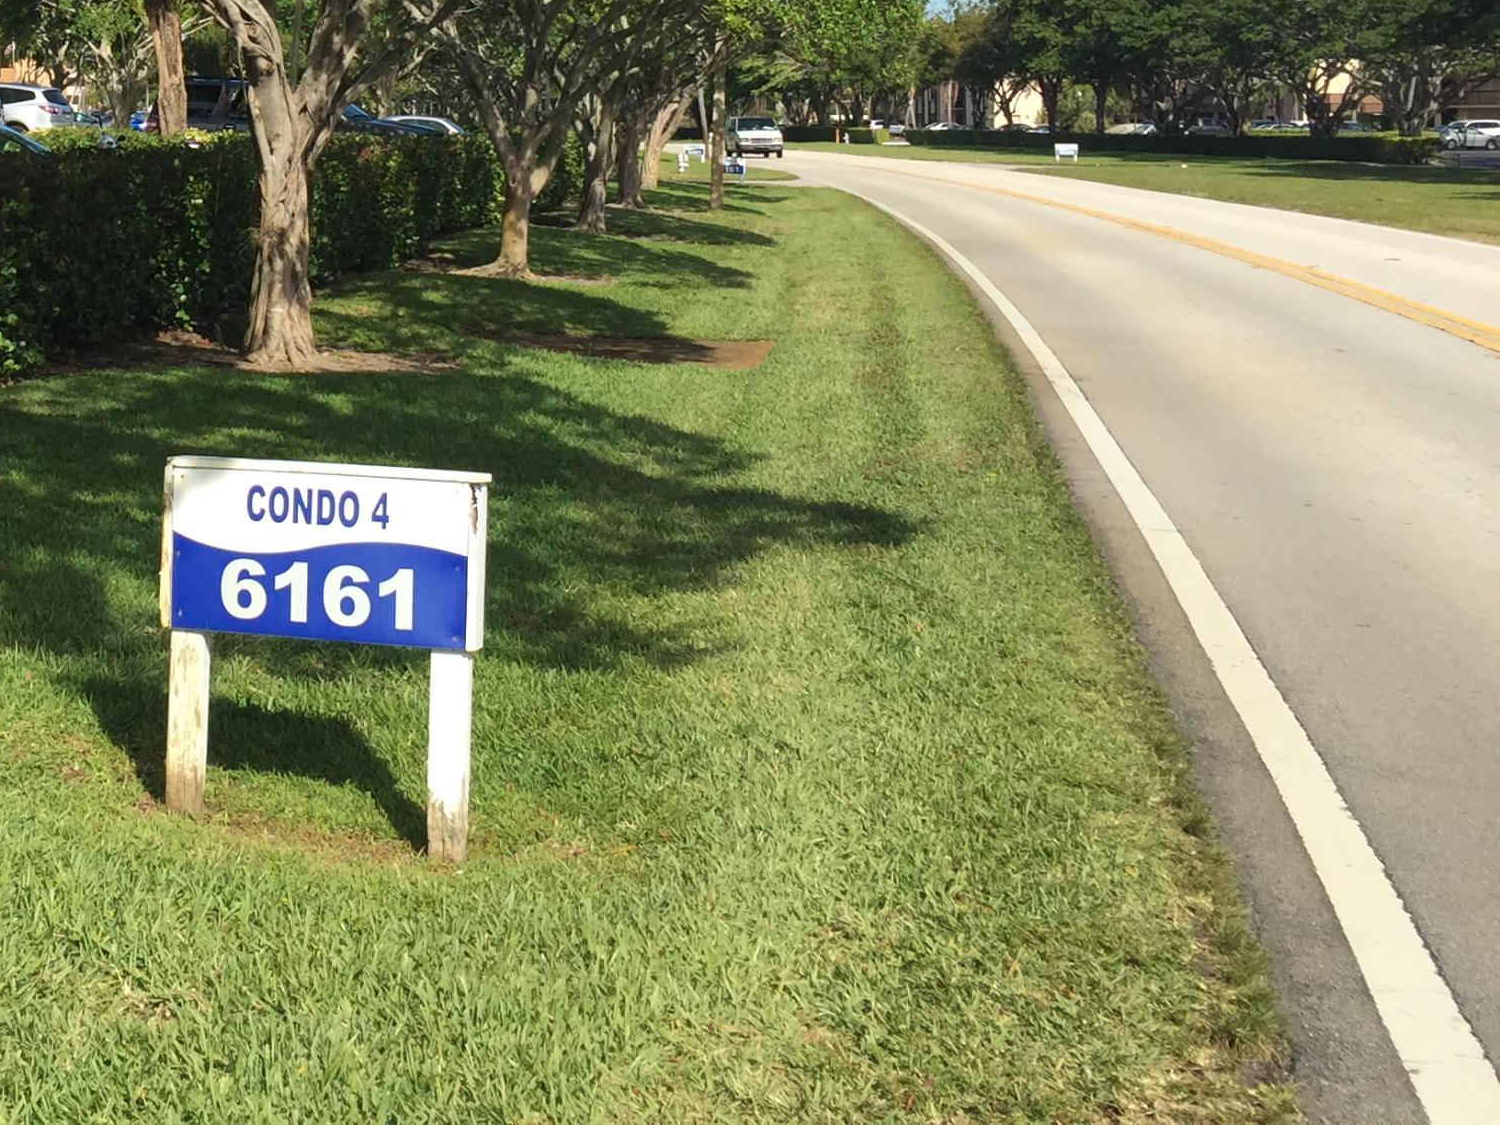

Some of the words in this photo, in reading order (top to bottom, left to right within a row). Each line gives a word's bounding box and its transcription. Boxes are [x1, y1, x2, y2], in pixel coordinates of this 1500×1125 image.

[247, 485, 359, 528] CONDO
[371, 492, 389, 529] 4
[220, 558, 414, 631] 6161
